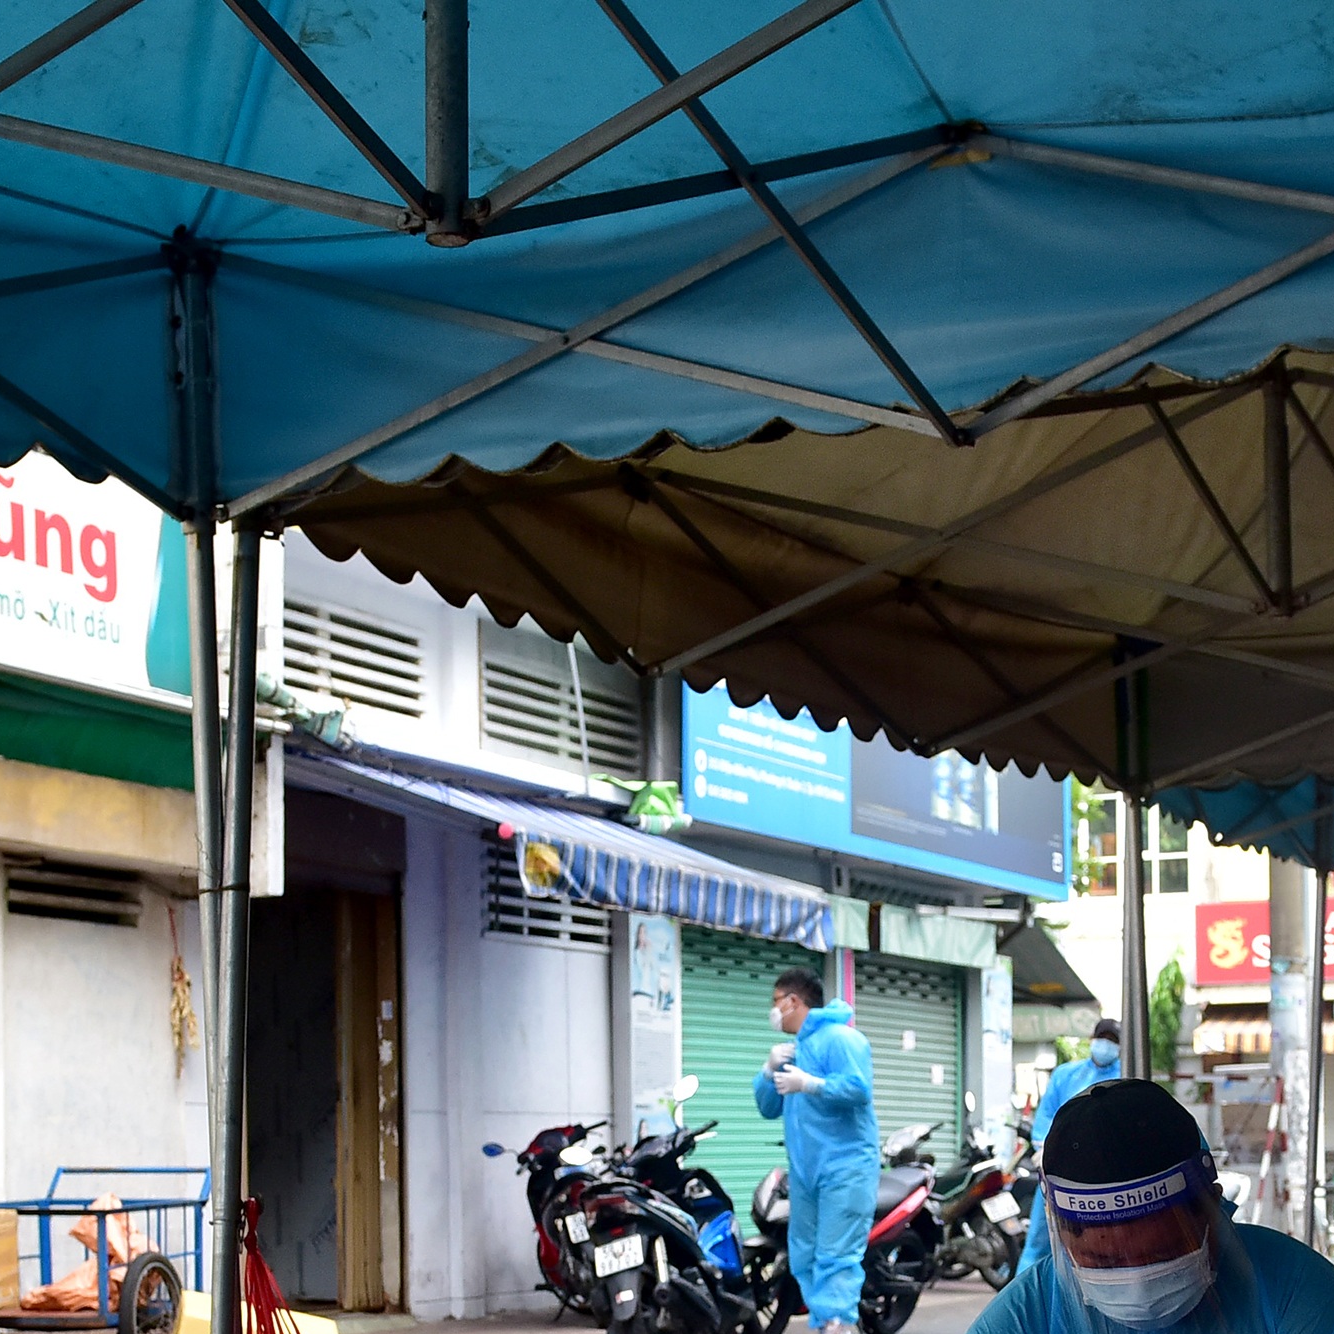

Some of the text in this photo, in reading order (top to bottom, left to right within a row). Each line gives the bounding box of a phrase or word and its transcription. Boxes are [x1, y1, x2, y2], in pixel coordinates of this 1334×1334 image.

[1068, 1182, 1168, 1210] Face Shield
[1076, 1200, 1167, 1221] Protective Isolation Mask
